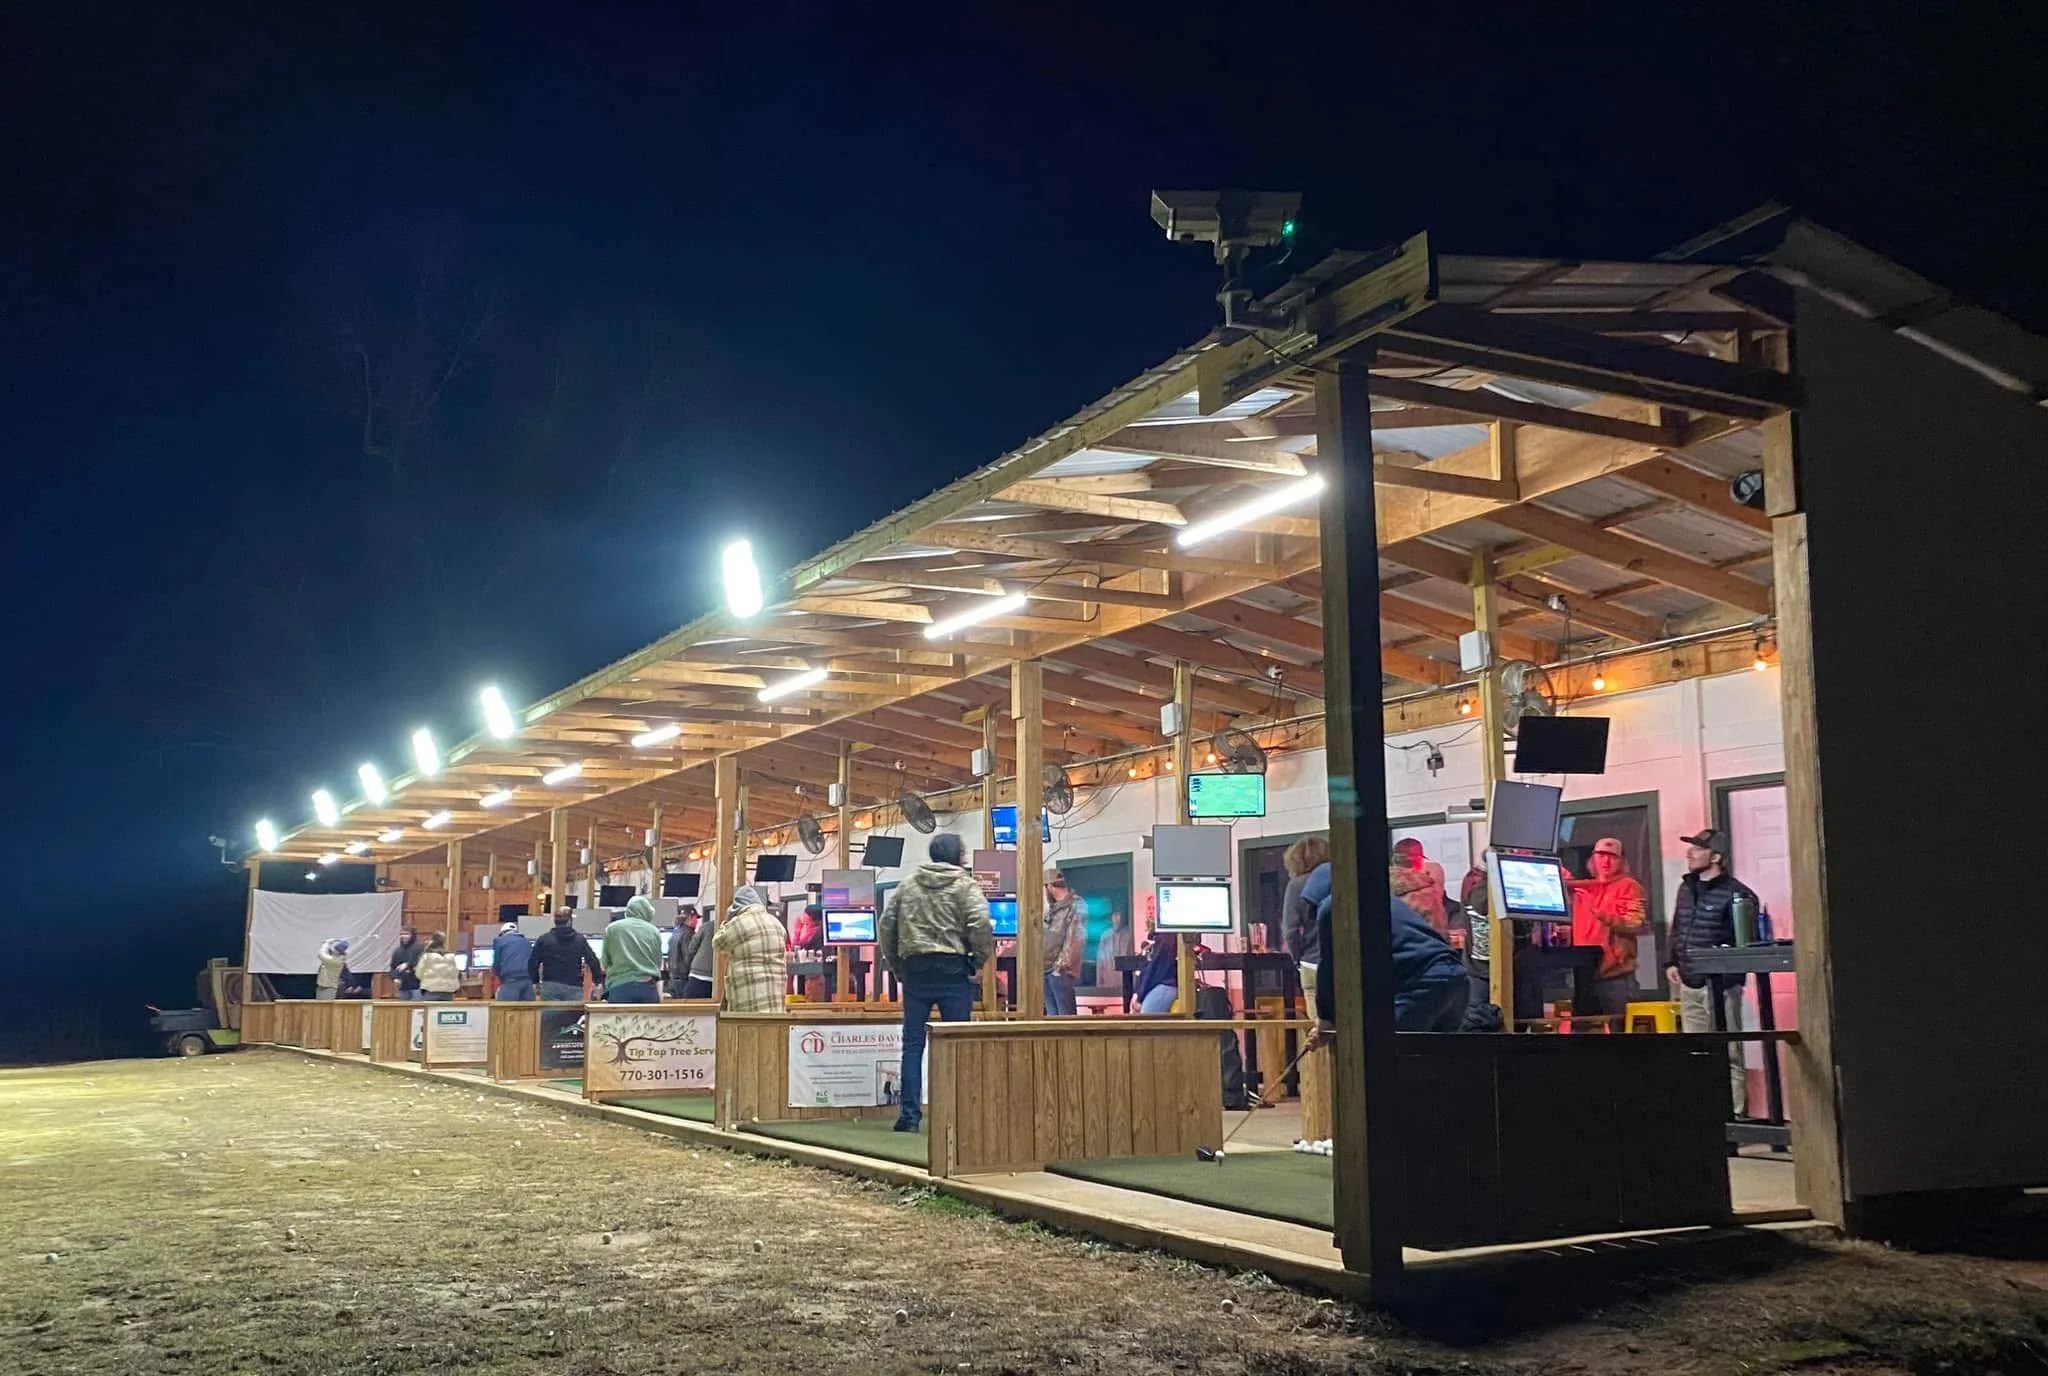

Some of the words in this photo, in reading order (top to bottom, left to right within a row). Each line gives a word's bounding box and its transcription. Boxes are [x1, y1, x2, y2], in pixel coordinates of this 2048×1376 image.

[831, 1034, 876, 1043] CHARLES
[878, 1034, 901, 1042] DAVI
[801, 1038, 824, 1054] CD
[630, 1048, 644, 1058] Tip
[647, 1047, 667, 1058] Top
[670, 1047, 692, 1055] Tree
[620, 1068, 704, 1081] 770-301-1516
